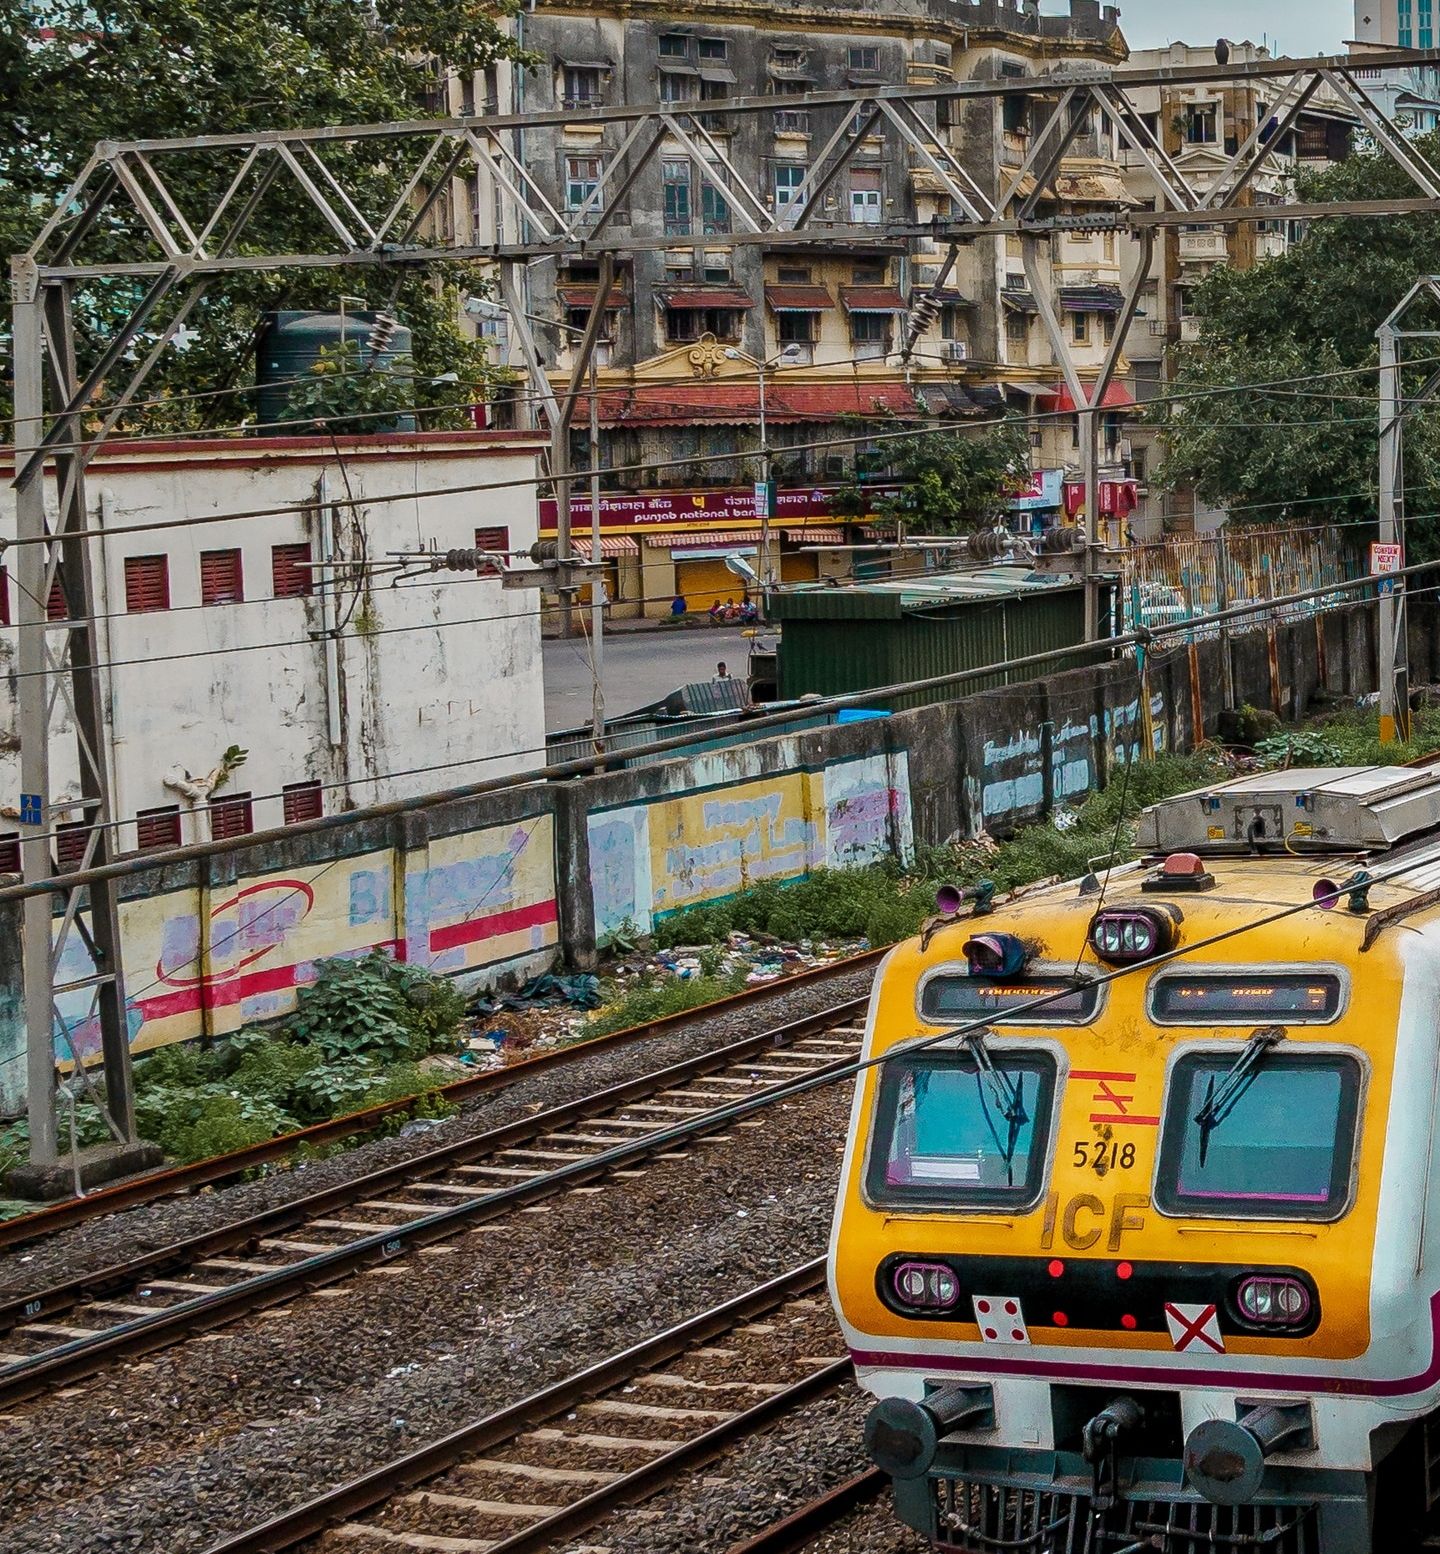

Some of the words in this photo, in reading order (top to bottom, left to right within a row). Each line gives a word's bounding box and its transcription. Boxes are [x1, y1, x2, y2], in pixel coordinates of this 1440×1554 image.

[634, 511, 676, 523] punjab
[680, 508, 729, 519] national
[732, 507, 756, 517] ban
[1378, 555, 1395, 563] NEXT
[1073, 1141, 1136, 1170] 5218
[1040, 1190, 1152, 1252] ICF
